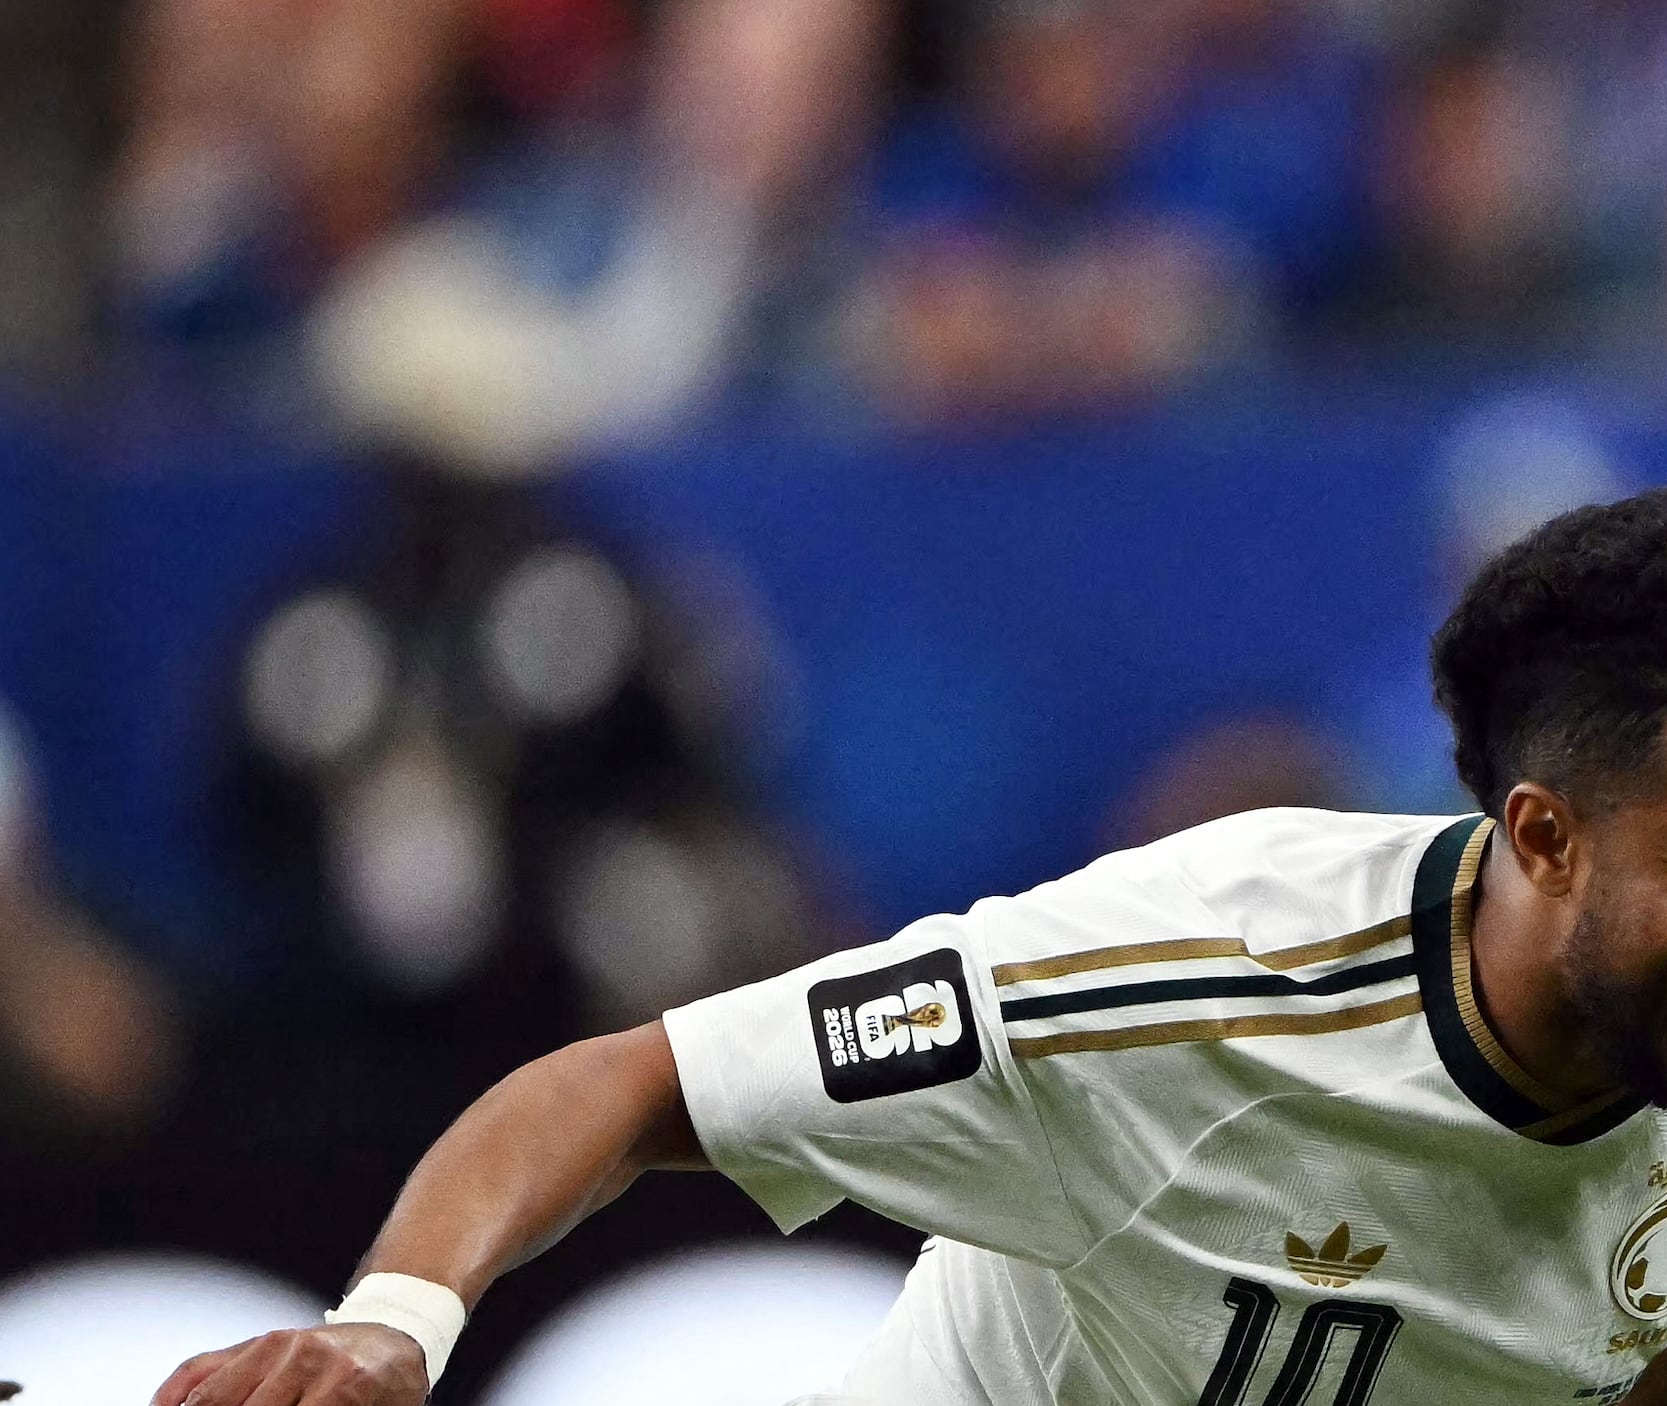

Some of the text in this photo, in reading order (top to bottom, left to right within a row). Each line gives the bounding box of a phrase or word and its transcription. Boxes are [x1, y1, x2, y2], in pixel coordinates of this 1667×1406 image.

[822, 1007, 848, 1067] 2026
[839, 1005, 860, 1064] WORLD CUP
[865, 1014, 880, 1043] FIFA
